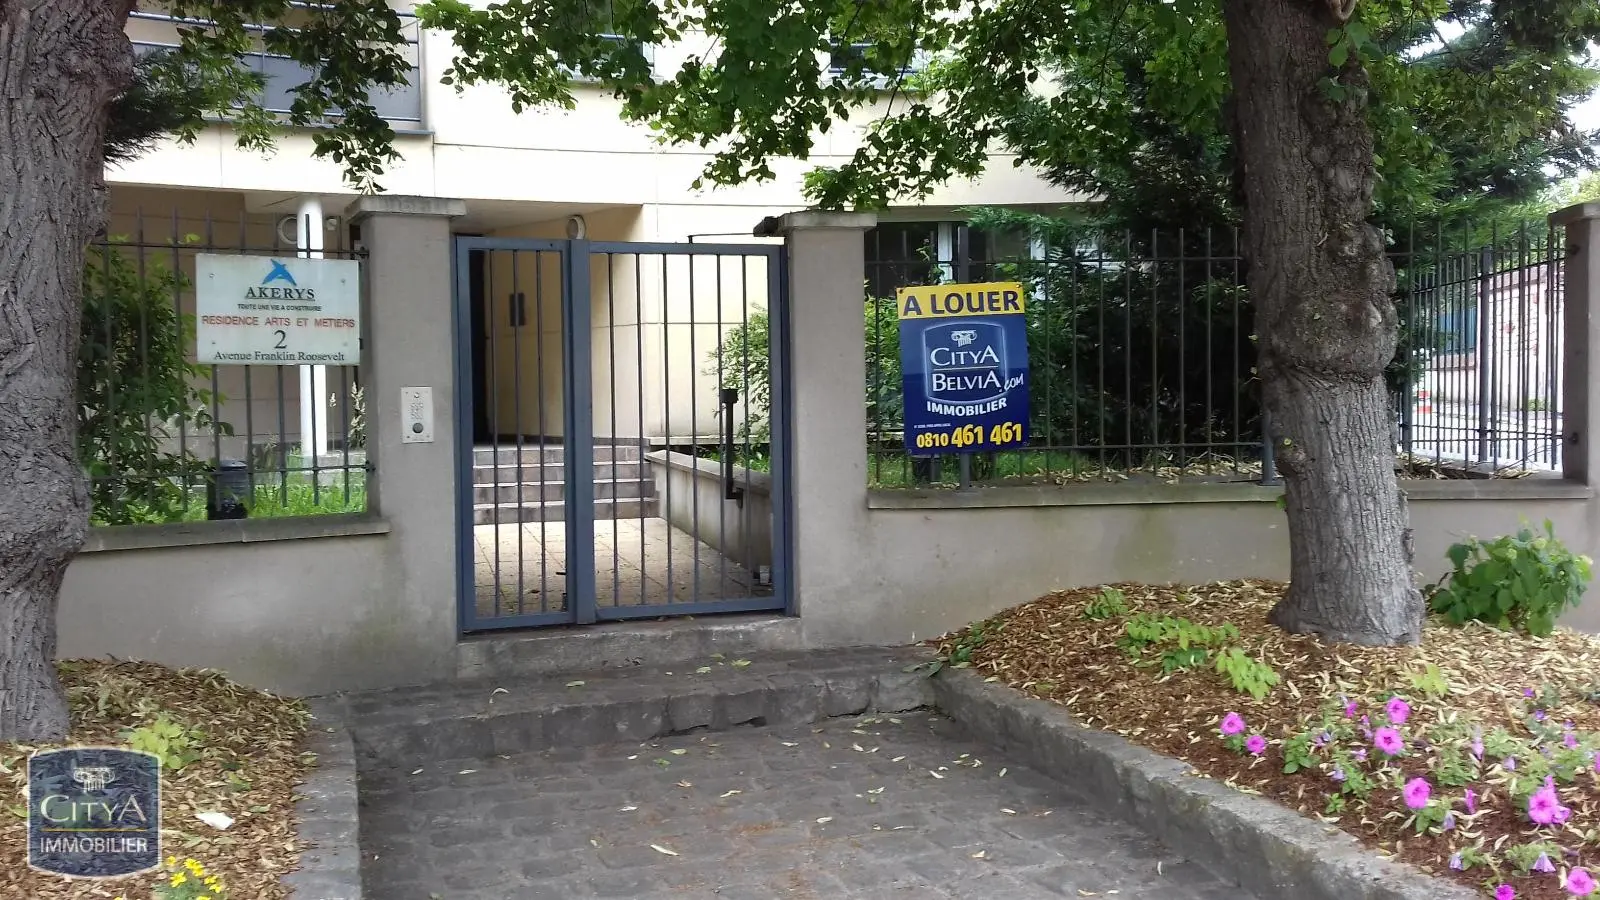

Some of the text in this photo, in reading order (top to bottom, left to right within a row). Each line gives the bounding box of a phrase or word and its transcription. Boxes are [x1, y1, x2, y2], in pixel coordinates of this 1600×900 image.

[245, 286, 315, 299] AKERYS
[903, 290, 1020, 316] A LOUER
[201, 315, 355, 328] RESIDENCE ARTS ET METIERS
[273, 330, 287, 349] 2
[214, 351, 345, 361] Avenue Franklin Roosevelt
[930, 344, 1000, 366] CITYA
[932, 370, 1001, 392] BELVIA
[926, 397, 1007, 416] IMMOBILIER
[916, 421, 1022, 448] 0810 461 461
